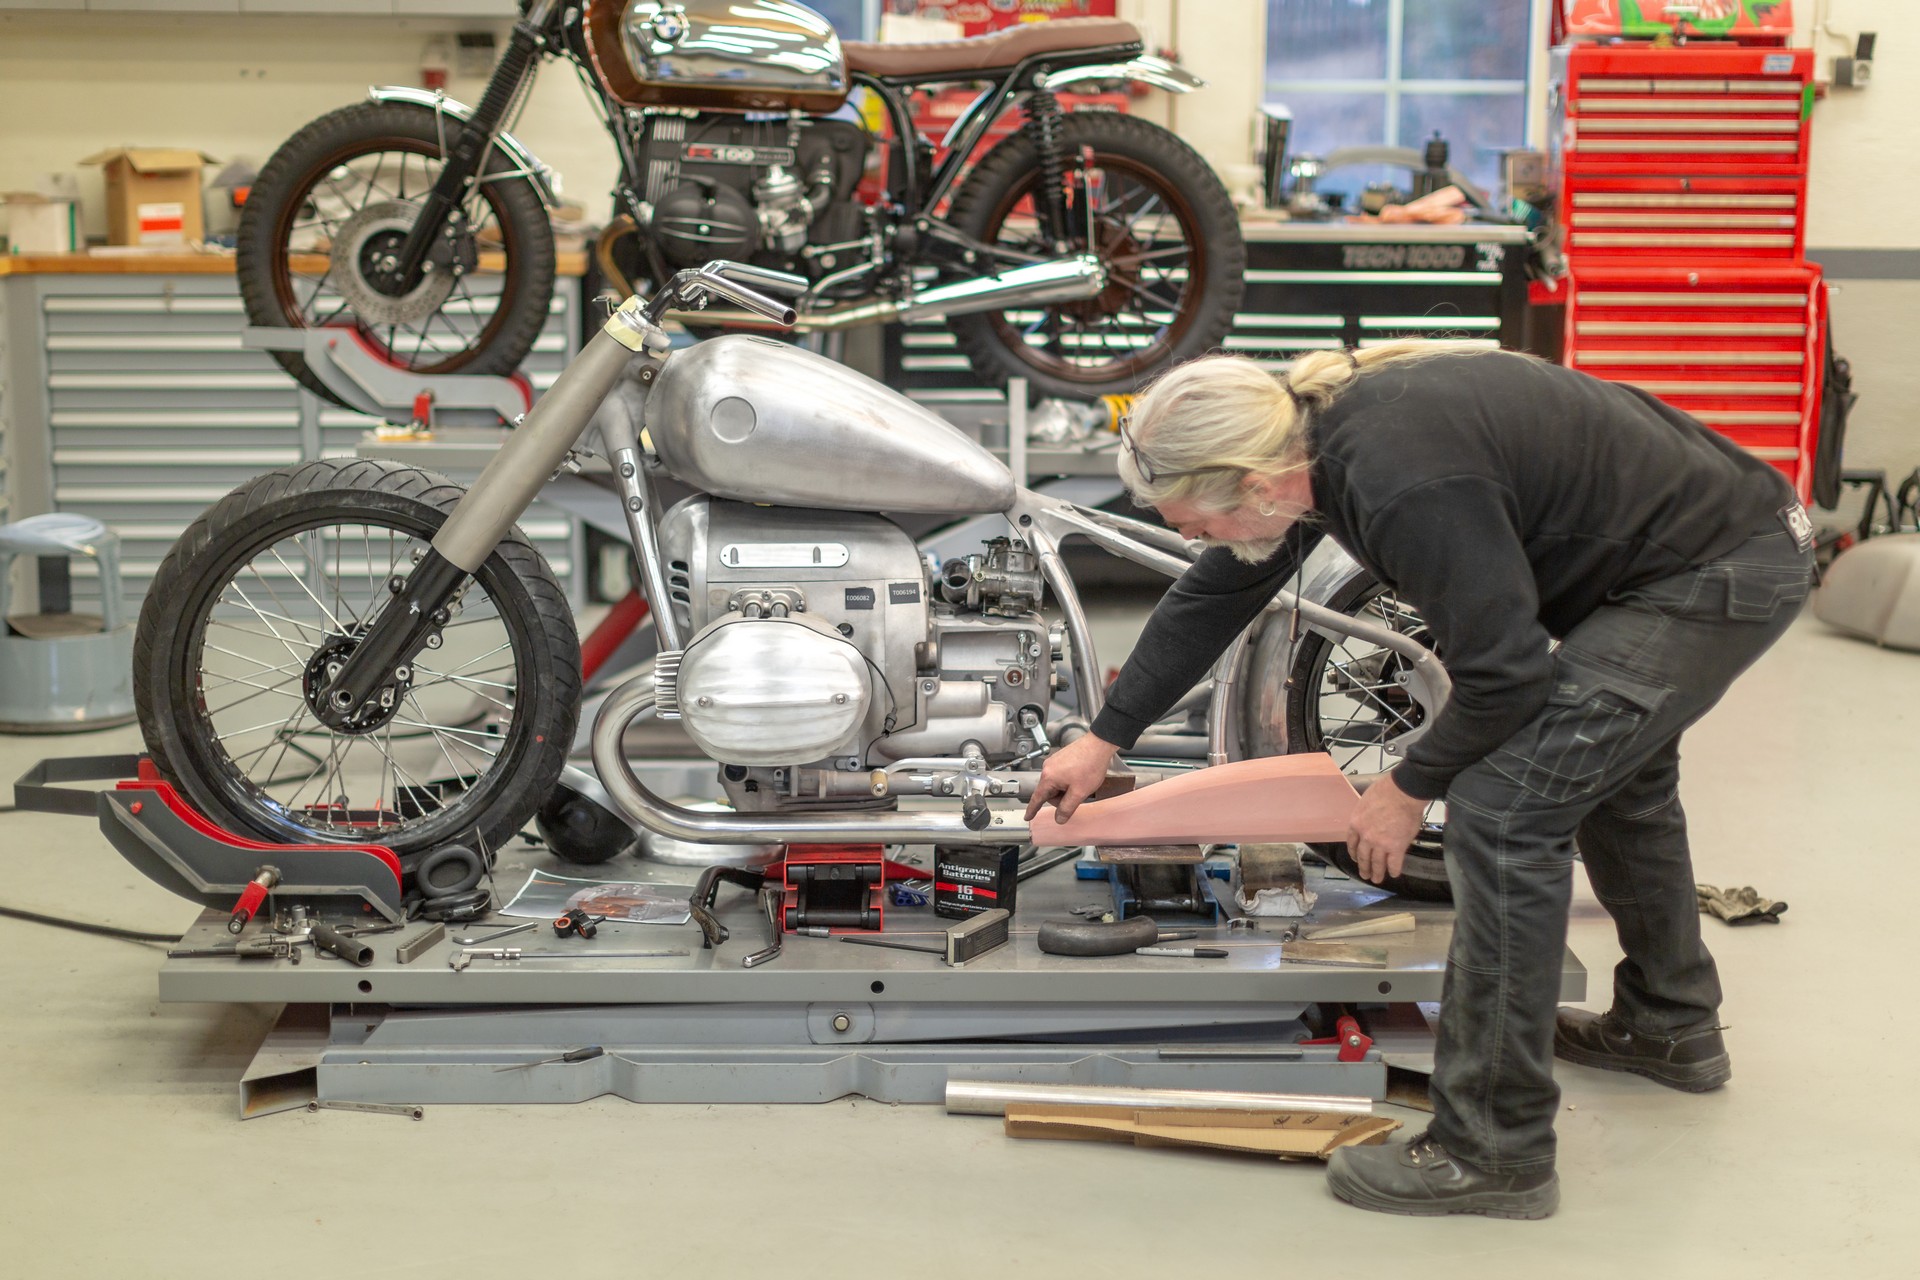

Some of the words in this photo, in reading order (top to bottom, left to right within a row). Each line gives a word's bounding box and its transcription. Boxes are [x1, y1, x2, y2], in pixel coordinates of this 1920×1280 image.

[1342, 244, 1405, 269] TECH
[1407, 244, 1466, 269] 1000
[938, 862, 996, 877] Antigravity
[942, 869, 991, 881] Batteries
[957, 884, 974, 895] 16
